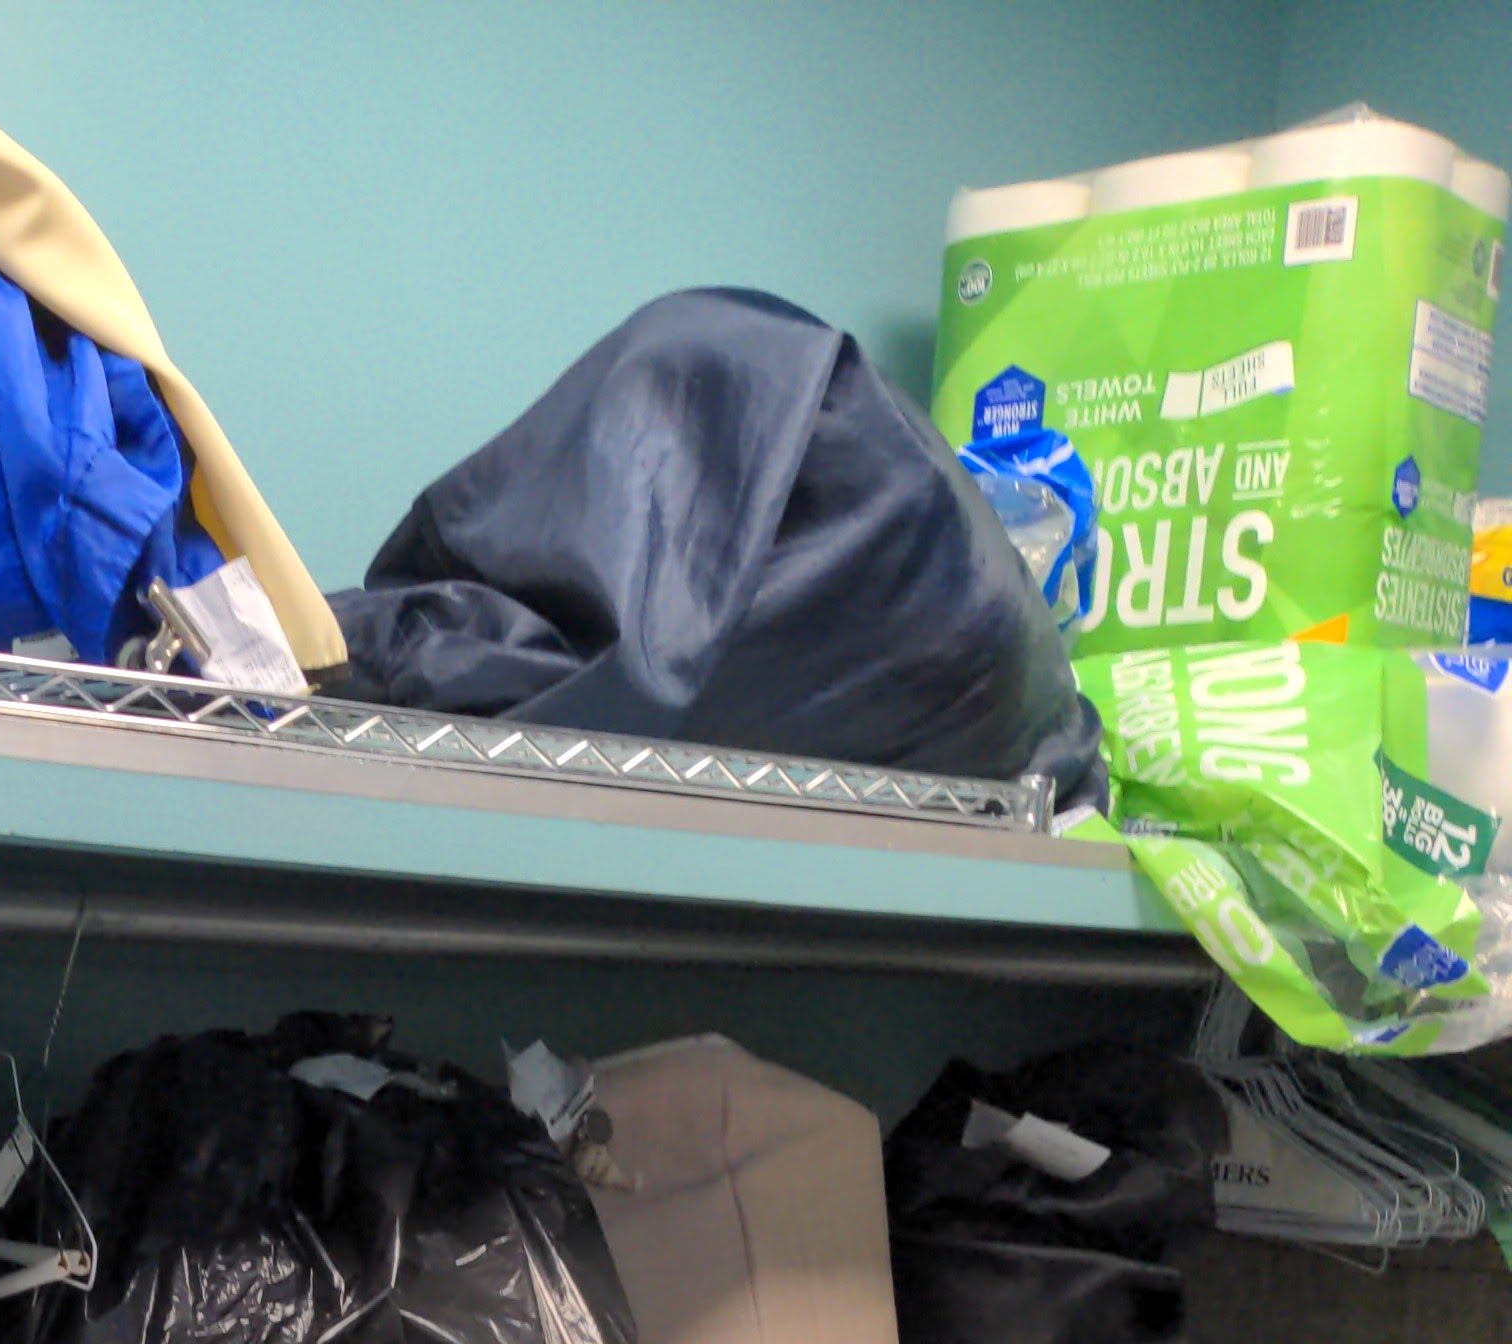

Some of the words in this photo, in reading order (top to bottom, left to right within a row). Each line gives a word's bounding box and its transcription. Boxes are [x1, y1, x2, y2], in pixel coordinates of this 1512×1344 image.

[1055, 370, 1157, 405] TOWELS
[1063, 401, 1143, 429] WHITE
[1090, 442, 1225, 515] ABSO
[1233, 451, 1292, 493] AND
[1414, 798, 1445, 856] BIG
[1431, 823, 1478, 870] 12
